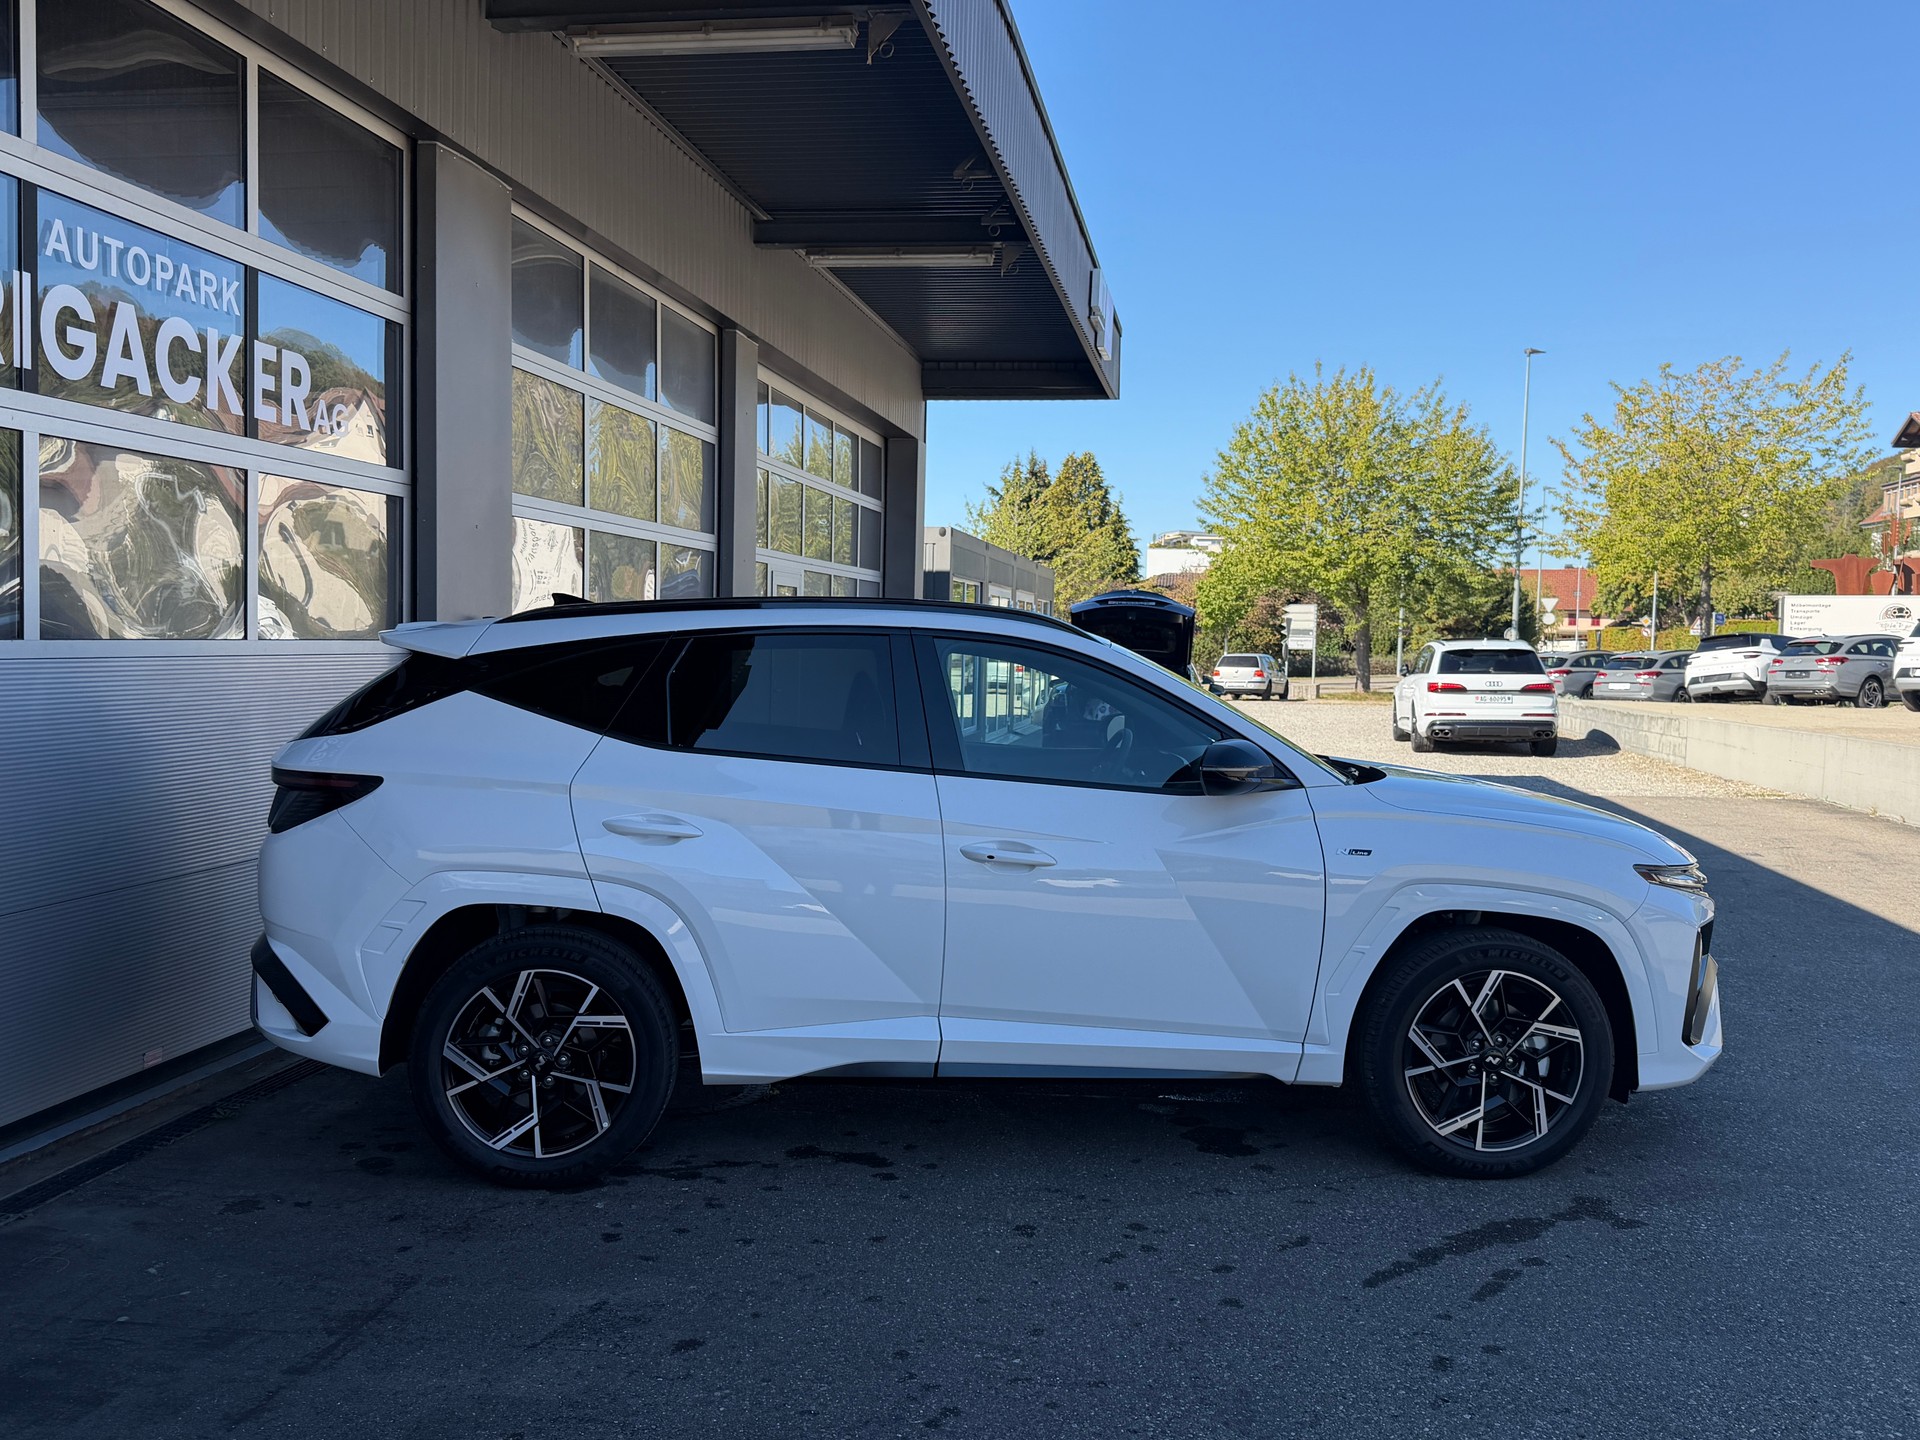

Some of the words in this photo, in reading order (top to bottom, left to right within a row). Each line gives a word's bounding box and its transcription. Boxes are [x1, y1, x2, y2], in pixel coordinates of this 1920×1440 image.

[45, 218, 241, 316] AUTOPARK
[0, 269, 312, 432] IGACKER
[313, 400, 349, 437] AG
[495, 947, 584, 964] MICHELIN
[1487, 948, 1567, 979] MICHELIN
